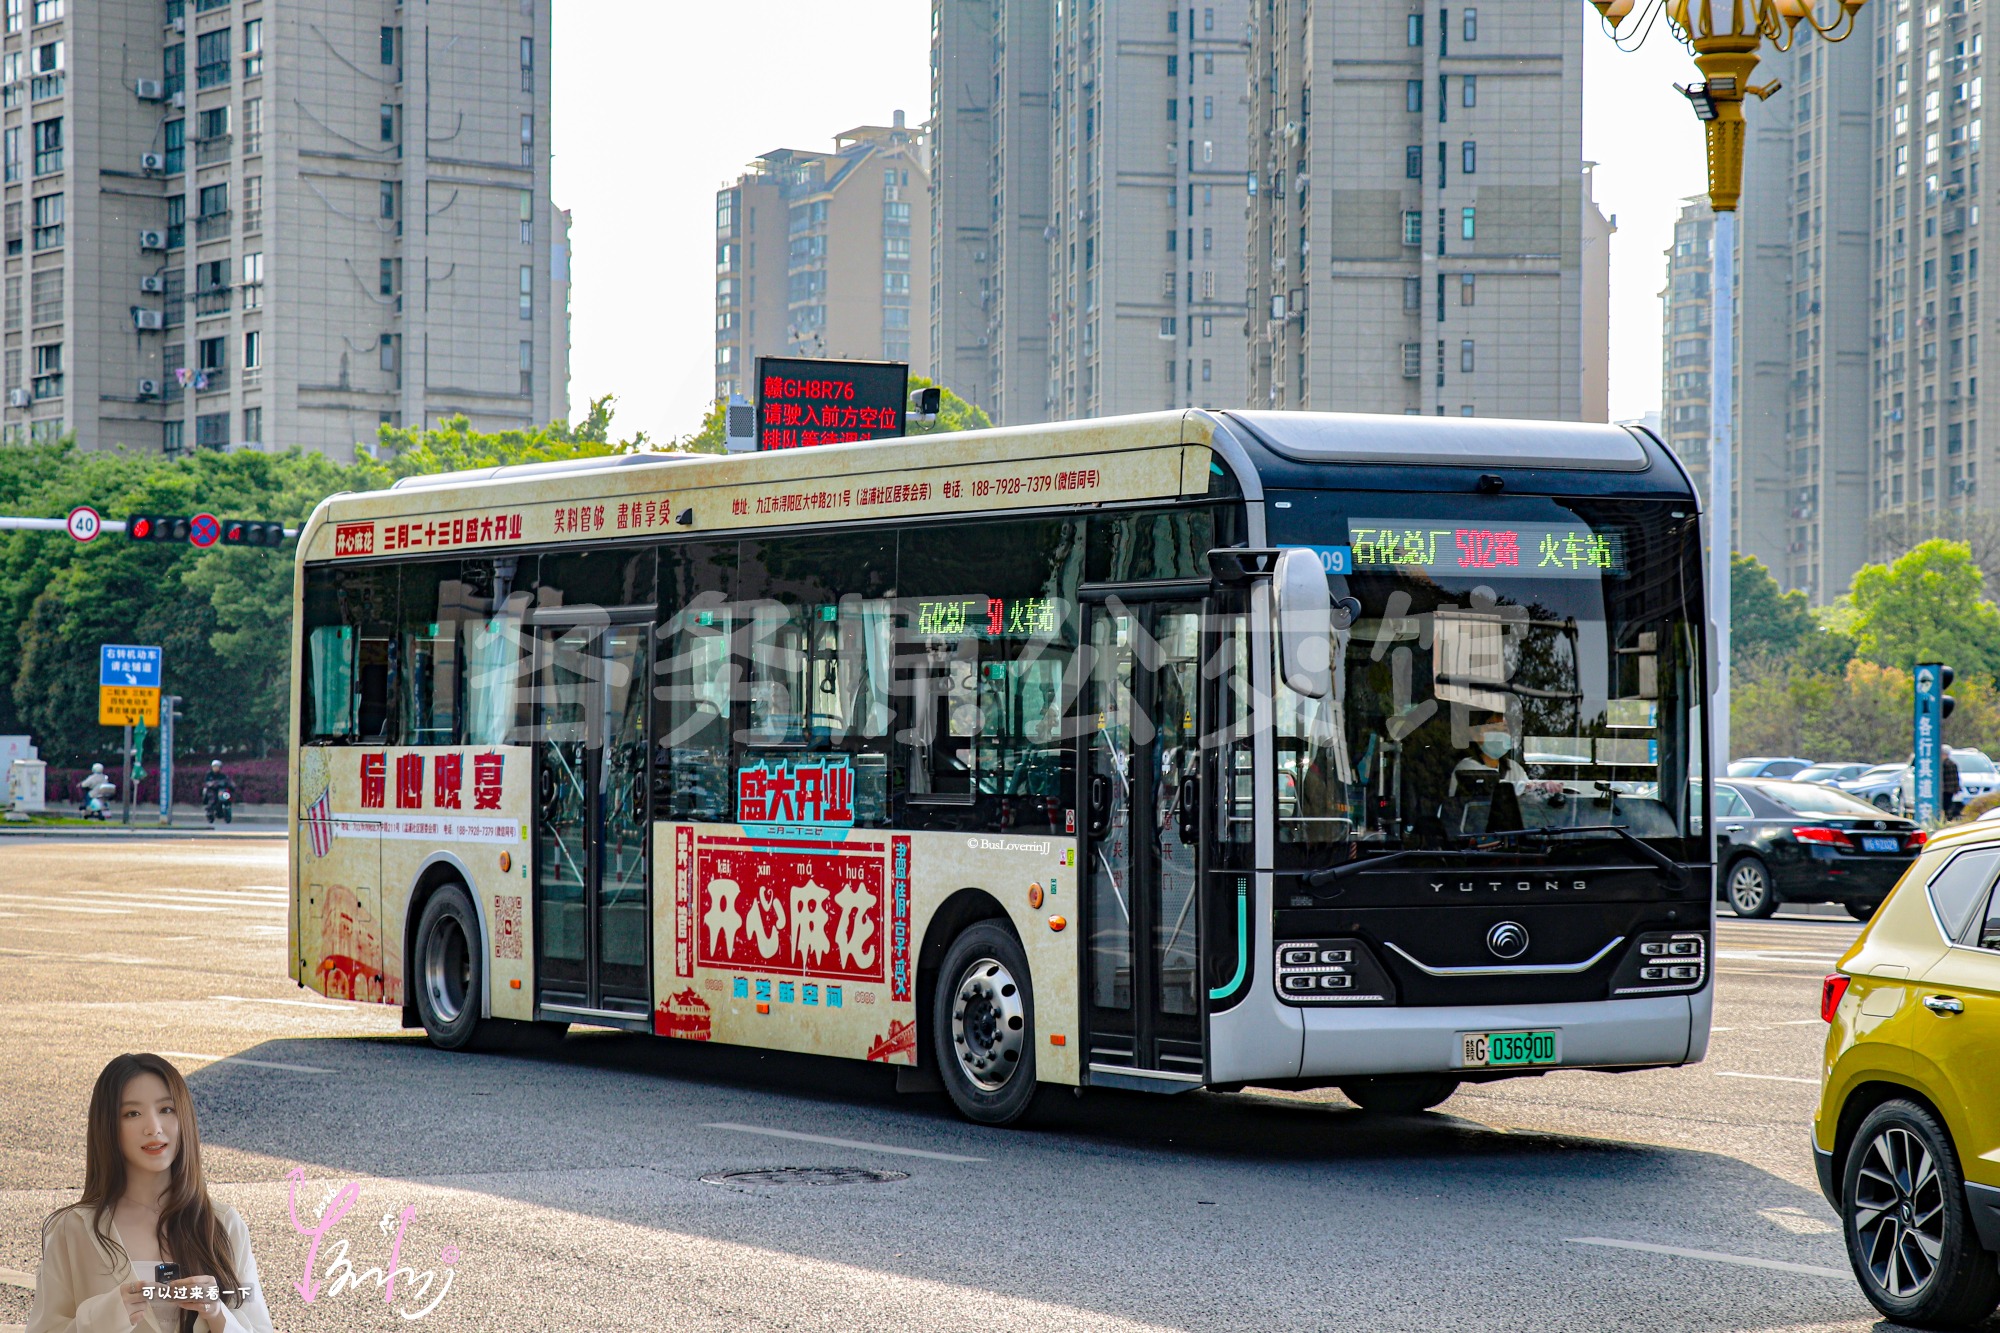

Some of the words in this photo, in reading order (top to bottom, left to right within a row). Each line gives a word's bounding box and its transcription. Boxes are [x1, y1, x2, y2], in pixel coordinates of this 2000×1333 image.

[764, 376, 855, 400] 赣GH8R76
[763, 402, 897, 430] 请驶入前方空位
[76, 517, 94, 531] 40
[554, 504, 605, 534] 笑料管够
[617, 498, 671, 529] 盡情享受
[336, 530, 374, 554] 开心麻花
[384, 513, 523, 550] 三月二十三日盛大开业
[1350, 529, 1452, 565] 石化总厂
[1455, 529, 1520, 569] 502路
[1537, 532, 1611, 569] 火车站
[919, 601, 976, 635] 石化总厂
[986, 598, 1005, 635] 50
[1007, 598, 1055, 635] 火车站
[106, 648, 158, 661] 右转机动车
[111, 661, 153, 673] 请走辅道
[738, 757, 855, 824] 盛大开业
[1430, 881, 1587, 893] YUTONG
[704, 879, 877, 969] 开心麻花
[1465, 1036, 1554, 1061] 赣G03690D
